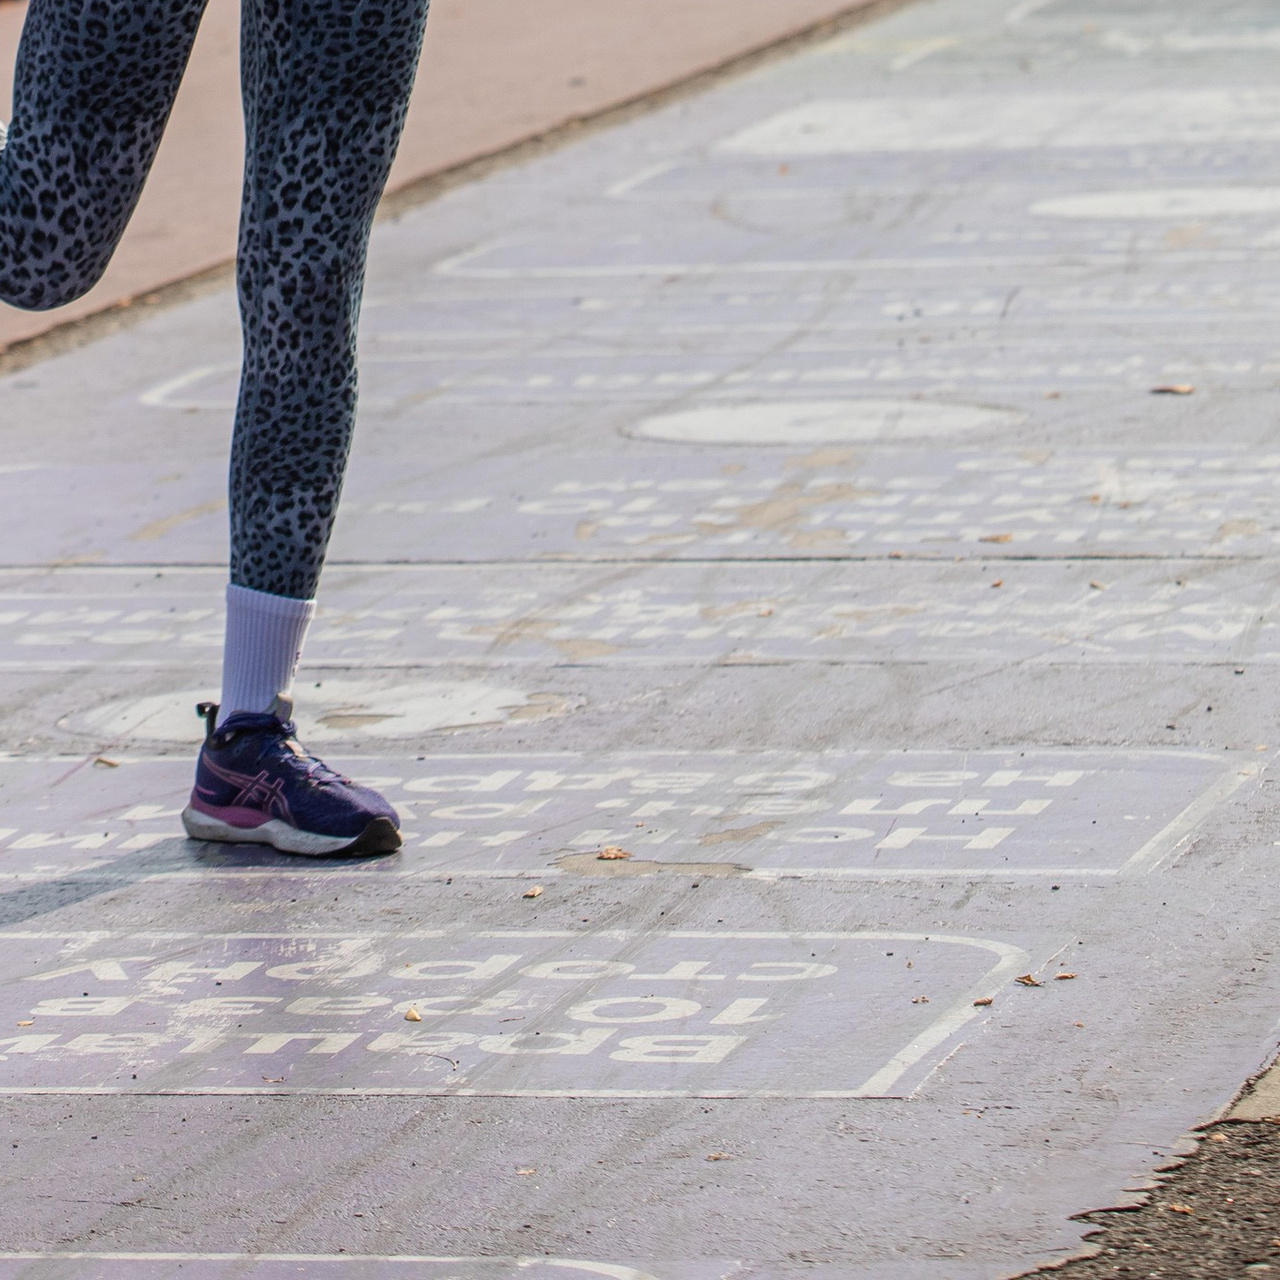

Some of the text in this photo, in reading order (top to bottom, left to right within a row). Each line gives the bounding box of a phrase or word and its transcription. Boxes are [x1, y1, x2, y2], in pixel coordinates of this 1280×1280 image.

[885, 770, 1083, 787] на
[26, 954, 838, 982] сторону
[29, 997, 130, 1016] в
[185, 989, 536, 1018] раз
[566, 995, 774, 1027] 10
